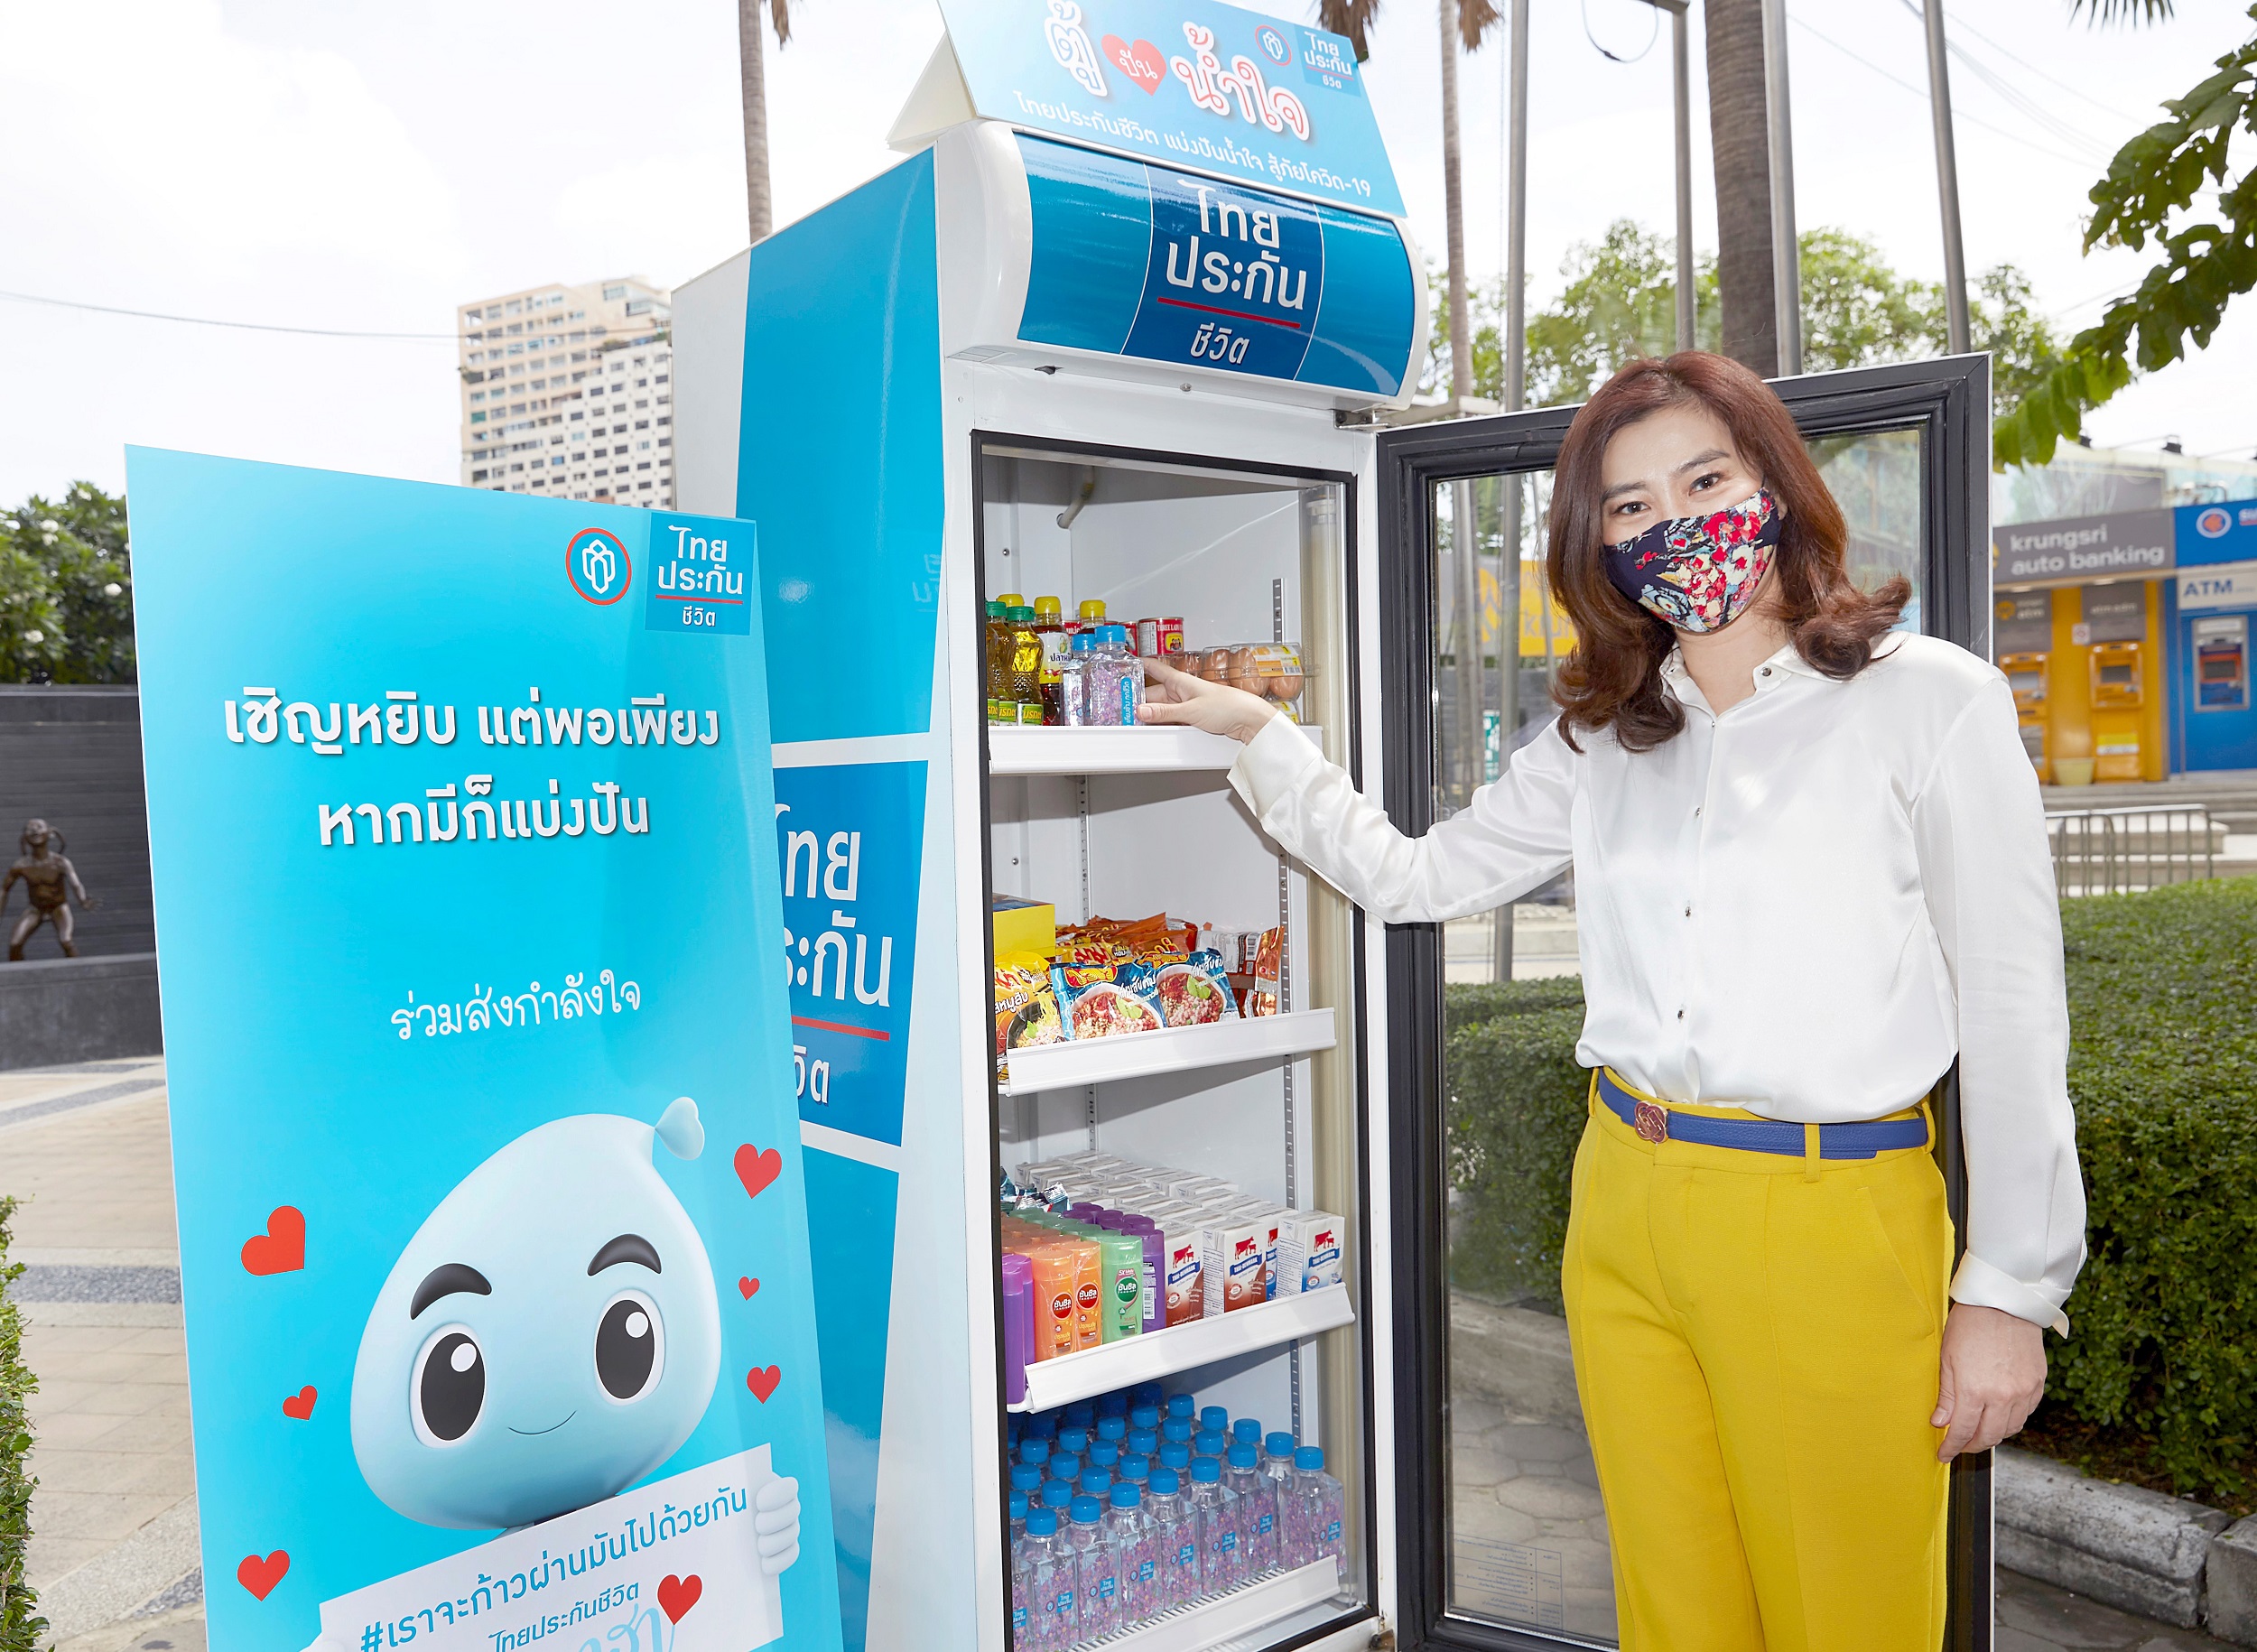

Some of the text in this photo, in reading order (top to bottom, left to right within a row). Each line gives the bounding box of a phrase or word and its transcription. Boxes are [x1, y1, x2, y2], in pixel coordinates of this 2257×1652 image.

[1305, 31, 1339, 57] ไทย
[1305, 51, 1352, 76] ประกัน
[1119, 49, 1158, 79] ปัน
[1171, 22, 1309, 141] น้ำใจ
[1322, 74, 1342, 89] ชีวิต
[1013, 90, 1371, 198] ไทยประกันชีวิต แบ่งปันน้ำใจ สู้ภัยโควิด-19
[1177, 179, 1280, 249] ไทย
[1166, 236, 1307, 311] ประกัน
[1190, 322, 1250, 365] ชีวิต
[668, 524, 728, 562] ไทย
[2010, 524, 2108, 552] krungsri
[2011, 544, 2165, 576] auto banking
[658, 560, 743, 595] ประกัน
[2183, 580, 2234, 598] ATM
[682, 606, 717, 627] ชีวิต
[224, 686, 720, 756] เชิญหยิบ แต่พอเพียง
[318, 773, 650, 847] หากมีก็แบ่งปัน
[775, 803, 860, 901] ทย
[390, 969, 641, 1040] ร่วมส่งกำลังใจ
[361, 1486, 748, 1652] #เราจะก้าวผ่านมันไปด้วยกัน
[488, 1582, 640, 1652] ไทยประกันชีวิต
